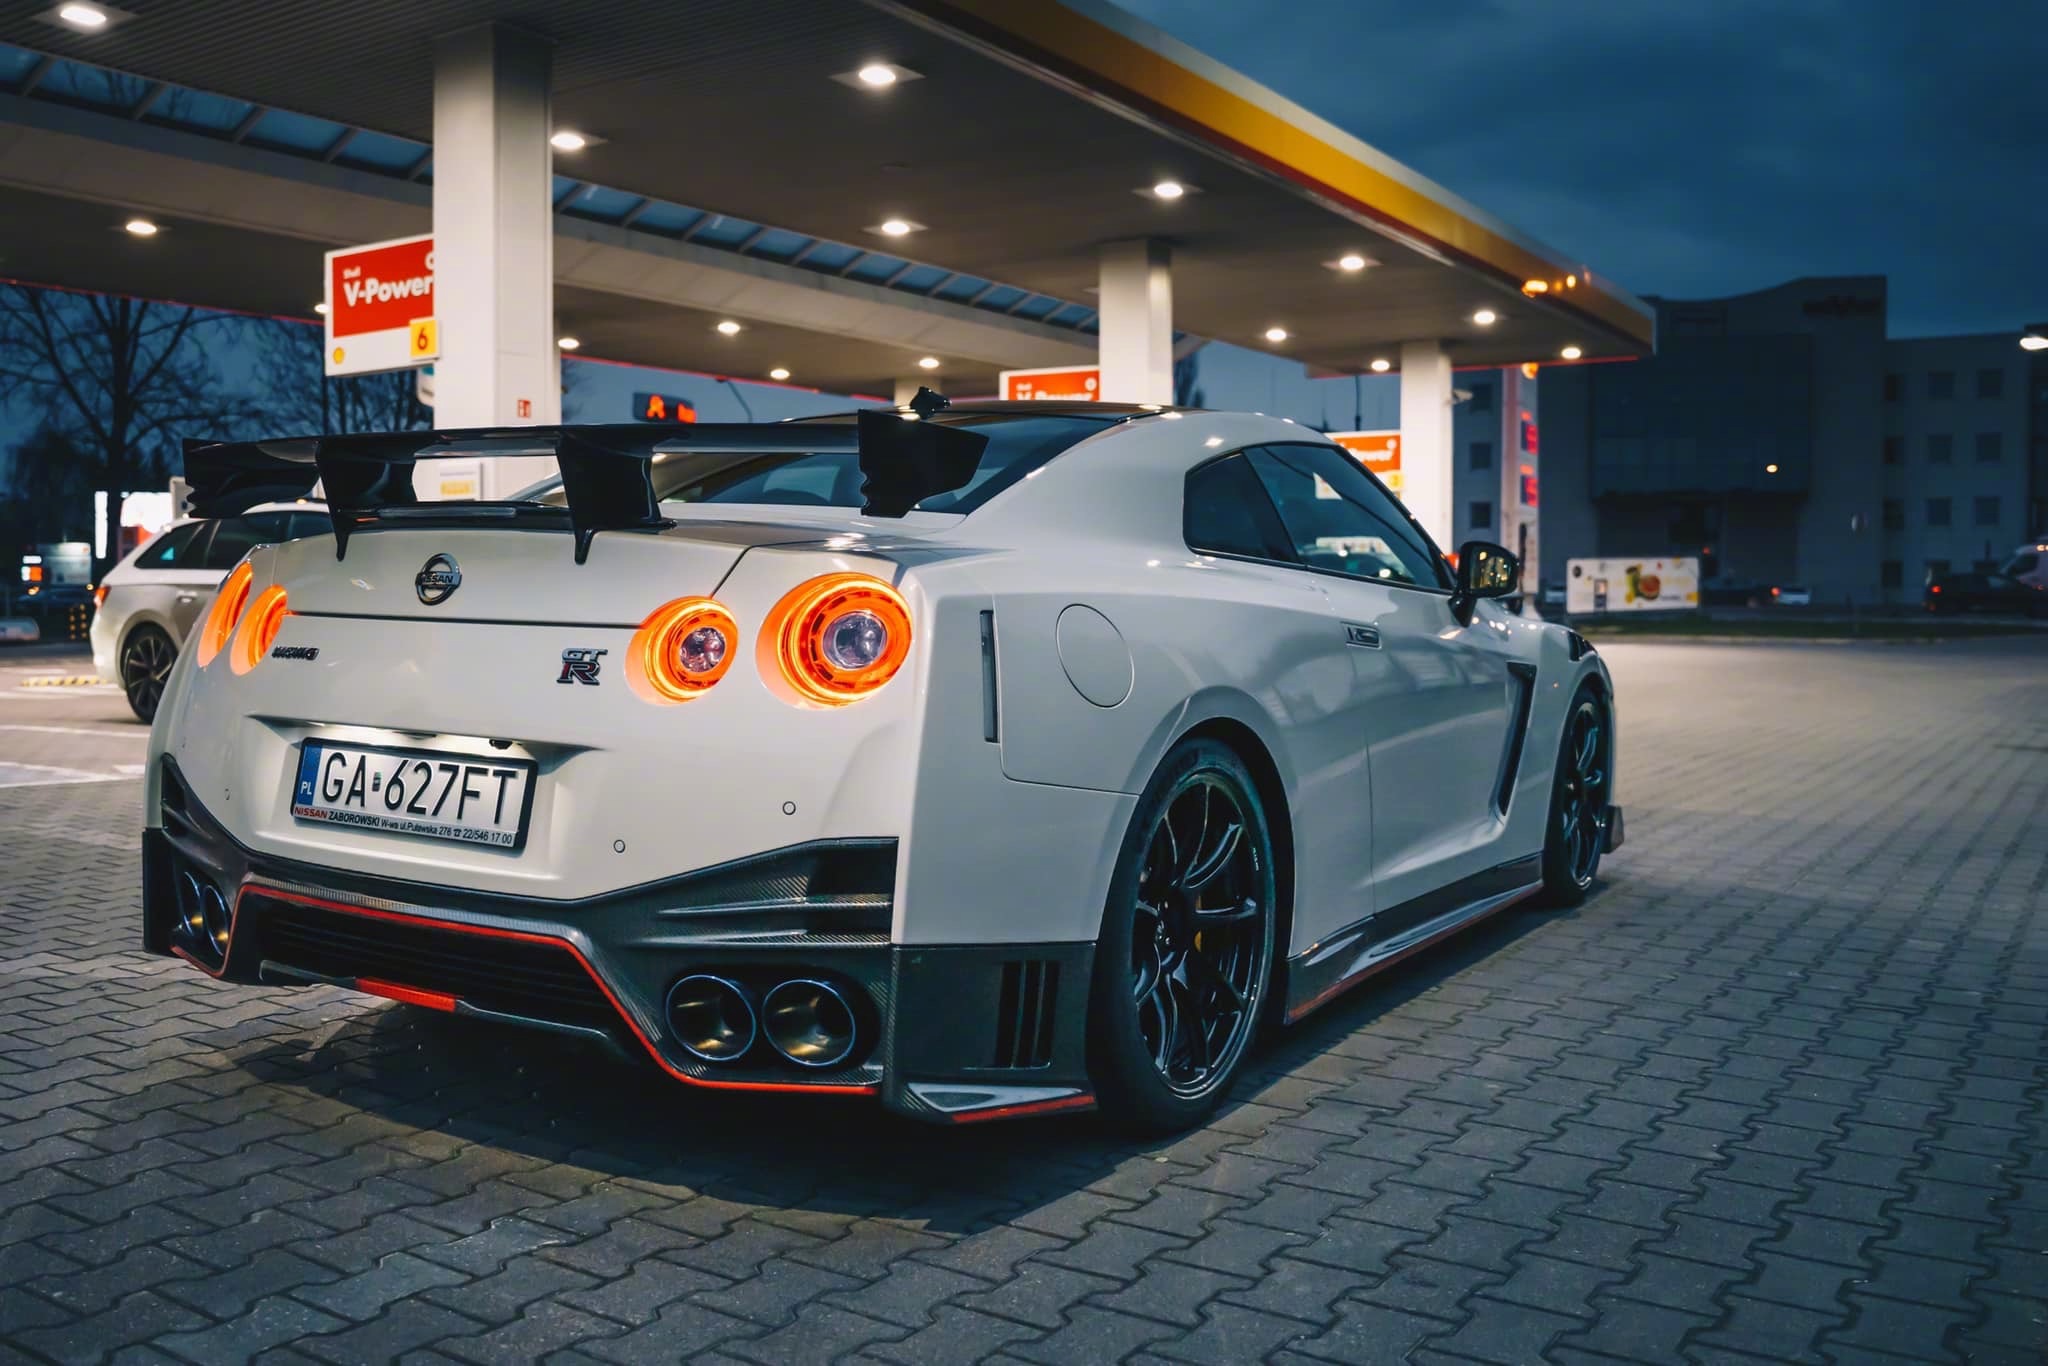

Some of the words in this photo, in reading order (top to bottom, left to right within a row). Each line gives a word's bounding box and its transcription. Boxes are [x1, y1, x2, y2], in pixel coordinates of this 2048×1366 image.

[343, 275, 434, 307] V-Power
[417, 327, 428, 350] 6
[418, 573, 455, 585] ISSAN
[562, 648, 608, 661] GT
[556, 660, 601, 686] R
[300, 781, 312, 795] PL
[322, 752, 367, 808] GA
[384, 759, 518, 825] 627FT
[294, 807, 328, 819] NISSAN
[328, 811, 380, 827] ZABOROWSKI
[491, 832, 500, 843] 17
[502, 834, 513, 845] 00
